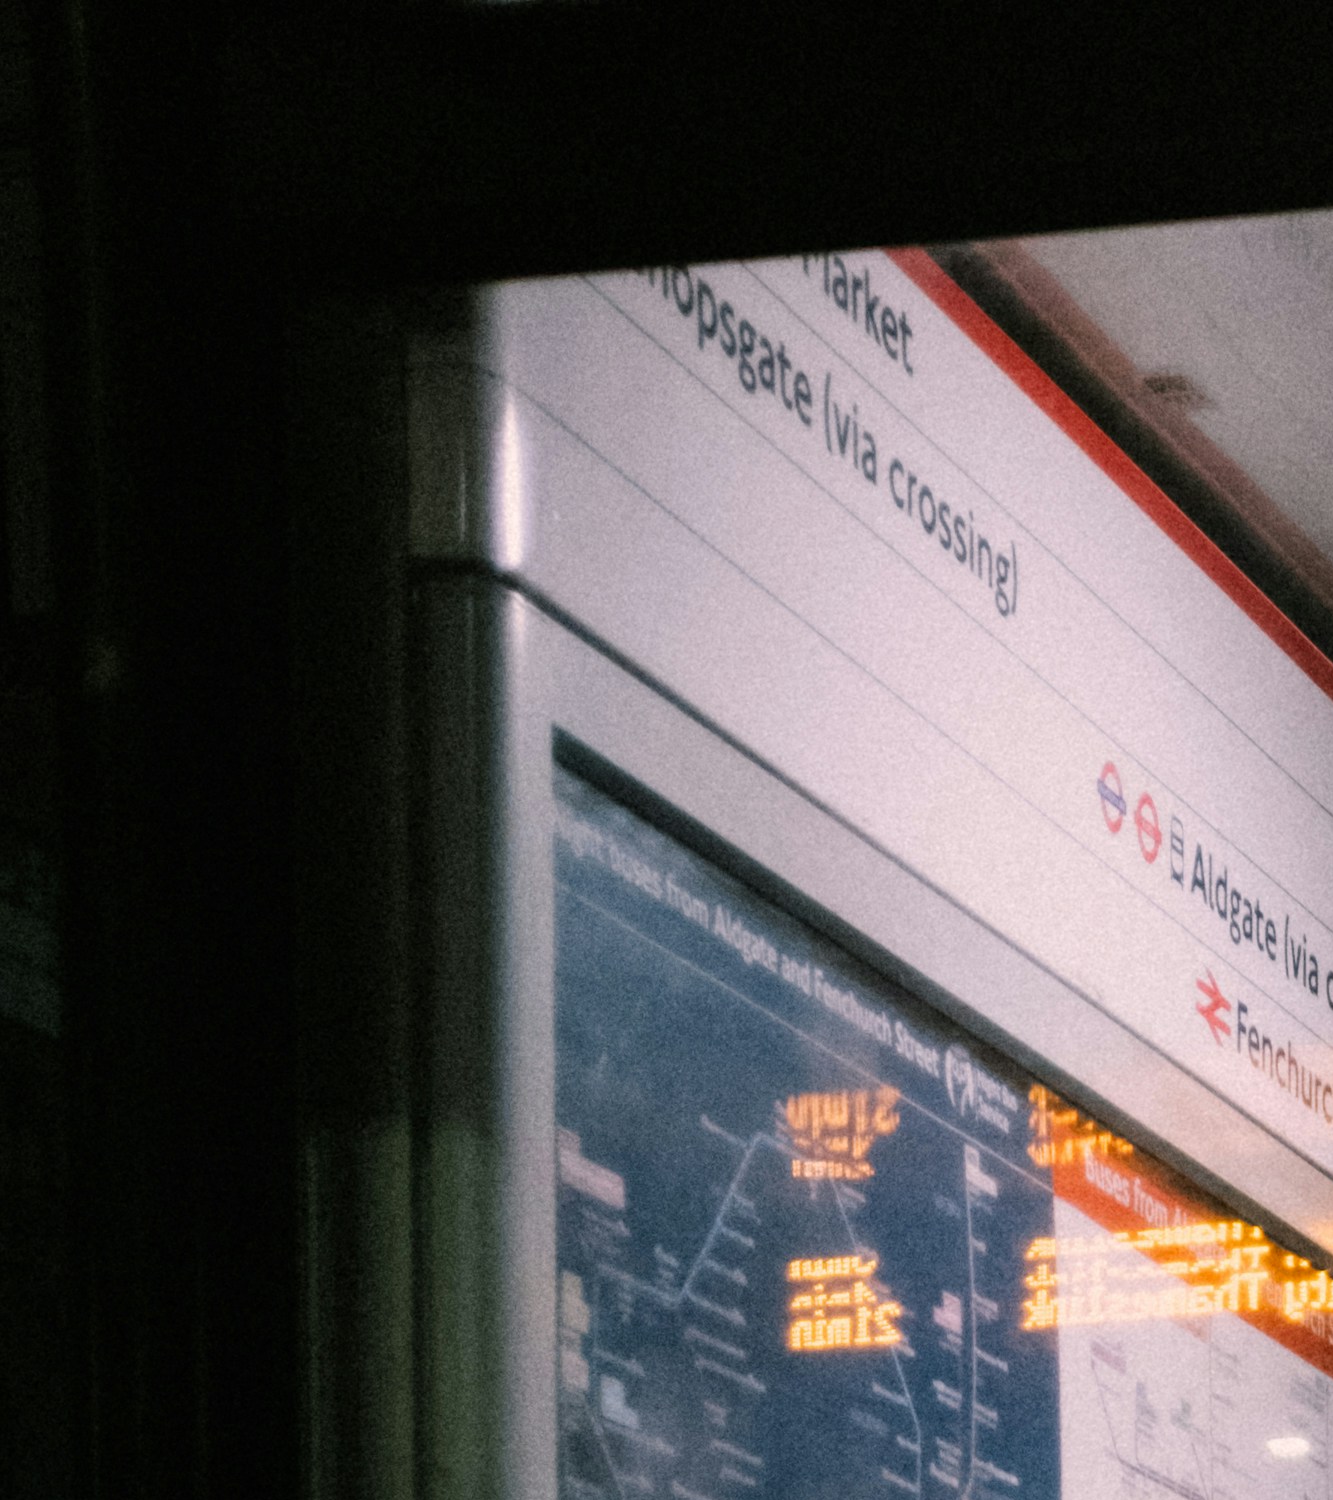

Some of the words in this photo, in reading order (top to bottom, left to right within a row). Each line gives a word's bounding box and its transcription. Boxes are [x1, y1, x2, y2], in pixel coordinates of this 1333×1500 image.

[823, 372, 878, 486] (via
[888, 458, 1018, 618] crossing)
[714, 903, 778, 976] Aldgate
[814, 966, 892, 1048] Fenchurch
[895, 1020, 940, 1079] Street
[1191, 843, 1277, 961] Aldgate
[1285, 914, 1320, 997] (via
